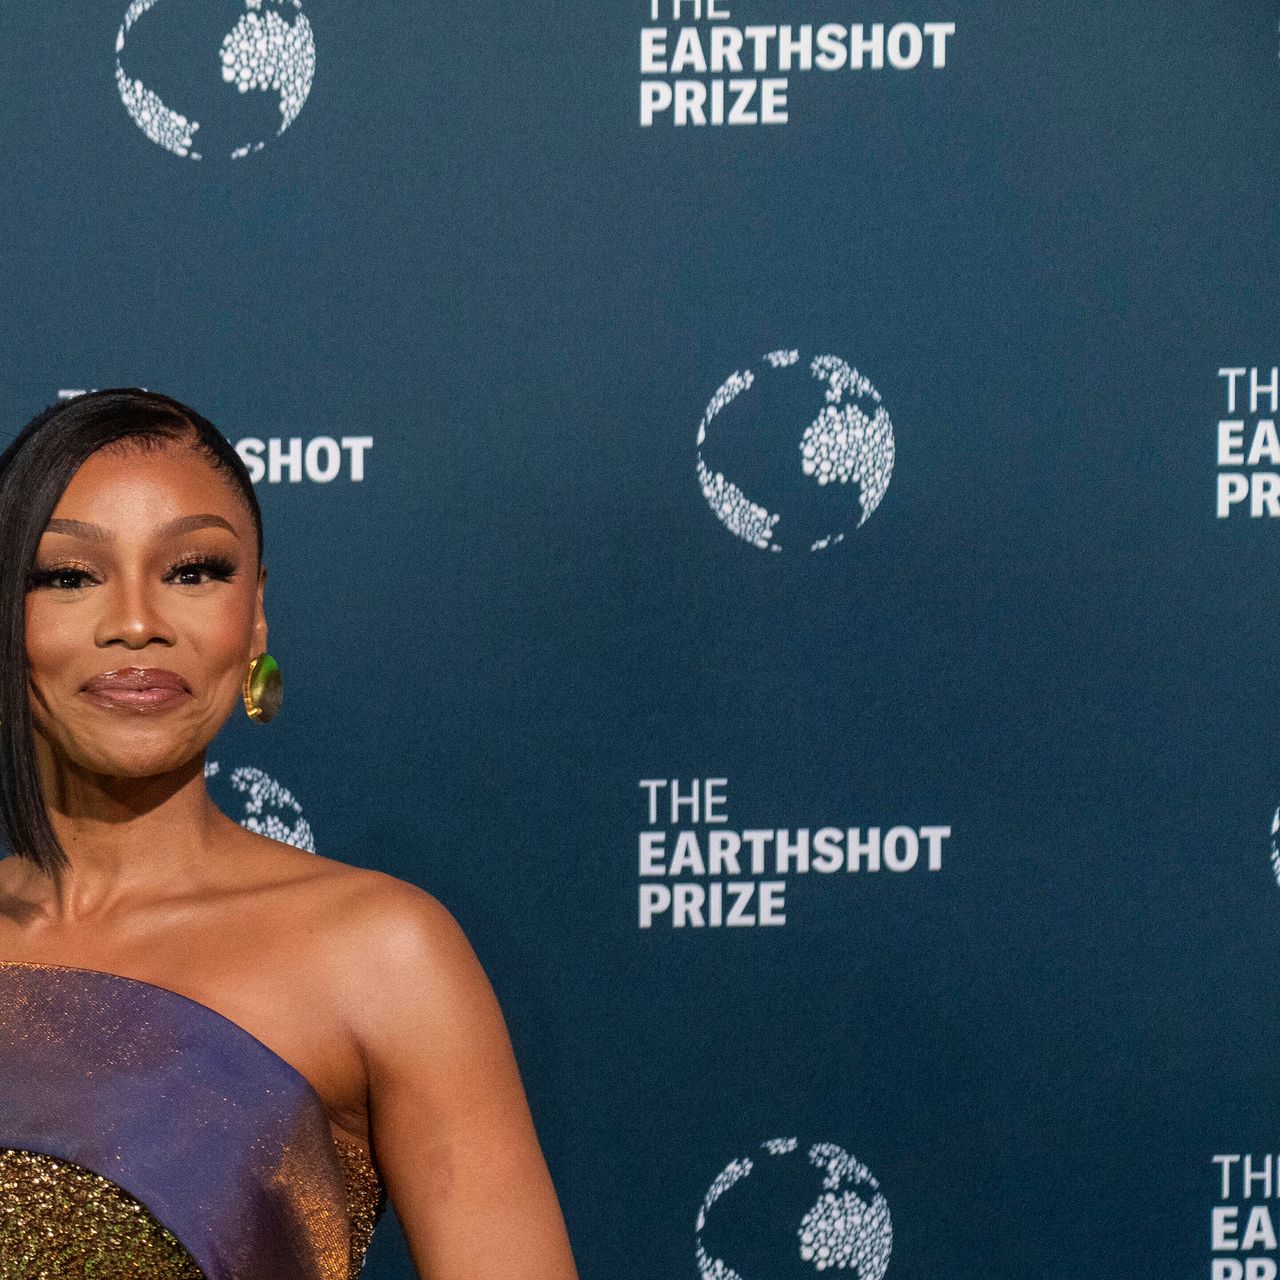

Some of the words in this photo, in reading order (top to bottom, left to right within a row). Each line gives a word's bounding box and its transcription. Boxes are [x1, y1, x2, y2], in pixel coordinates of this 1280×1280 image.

[641, 22, 955, 73] EARTHSHOT
[640, 78, 788, 126] PRIZE
[639, 778, 728, 823] THE
[639, 826, 951, 872] EARTHSHOT
[639, 881, 786, 928] PRIZE
[1212, 1154, 1280, 1198] TH
